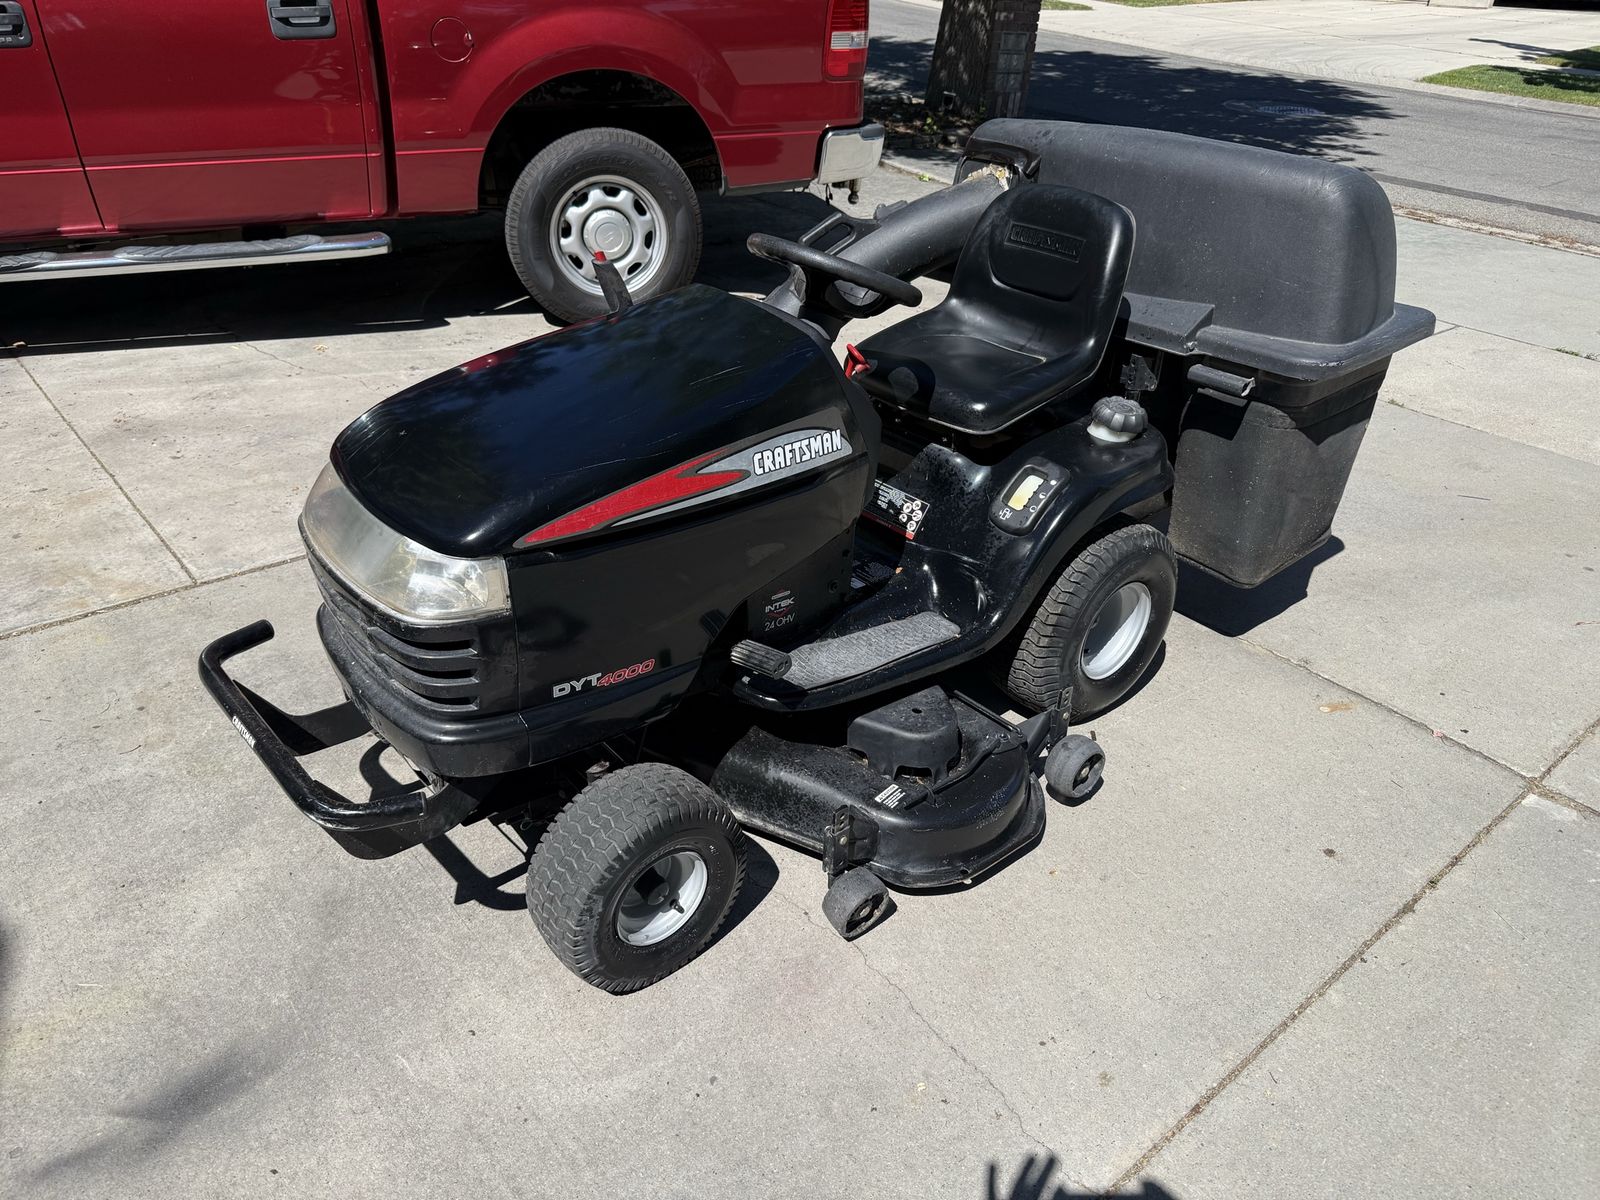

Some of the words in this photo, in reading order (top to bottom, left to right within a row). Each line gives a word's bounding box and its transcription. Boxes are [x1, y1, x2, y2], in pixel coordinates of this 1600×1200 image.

[752, 429, 842, 477] CRAFTSMAN
[765, 597, 796, 614] INTEK
[552, 658, 656, 699] DYT4000
